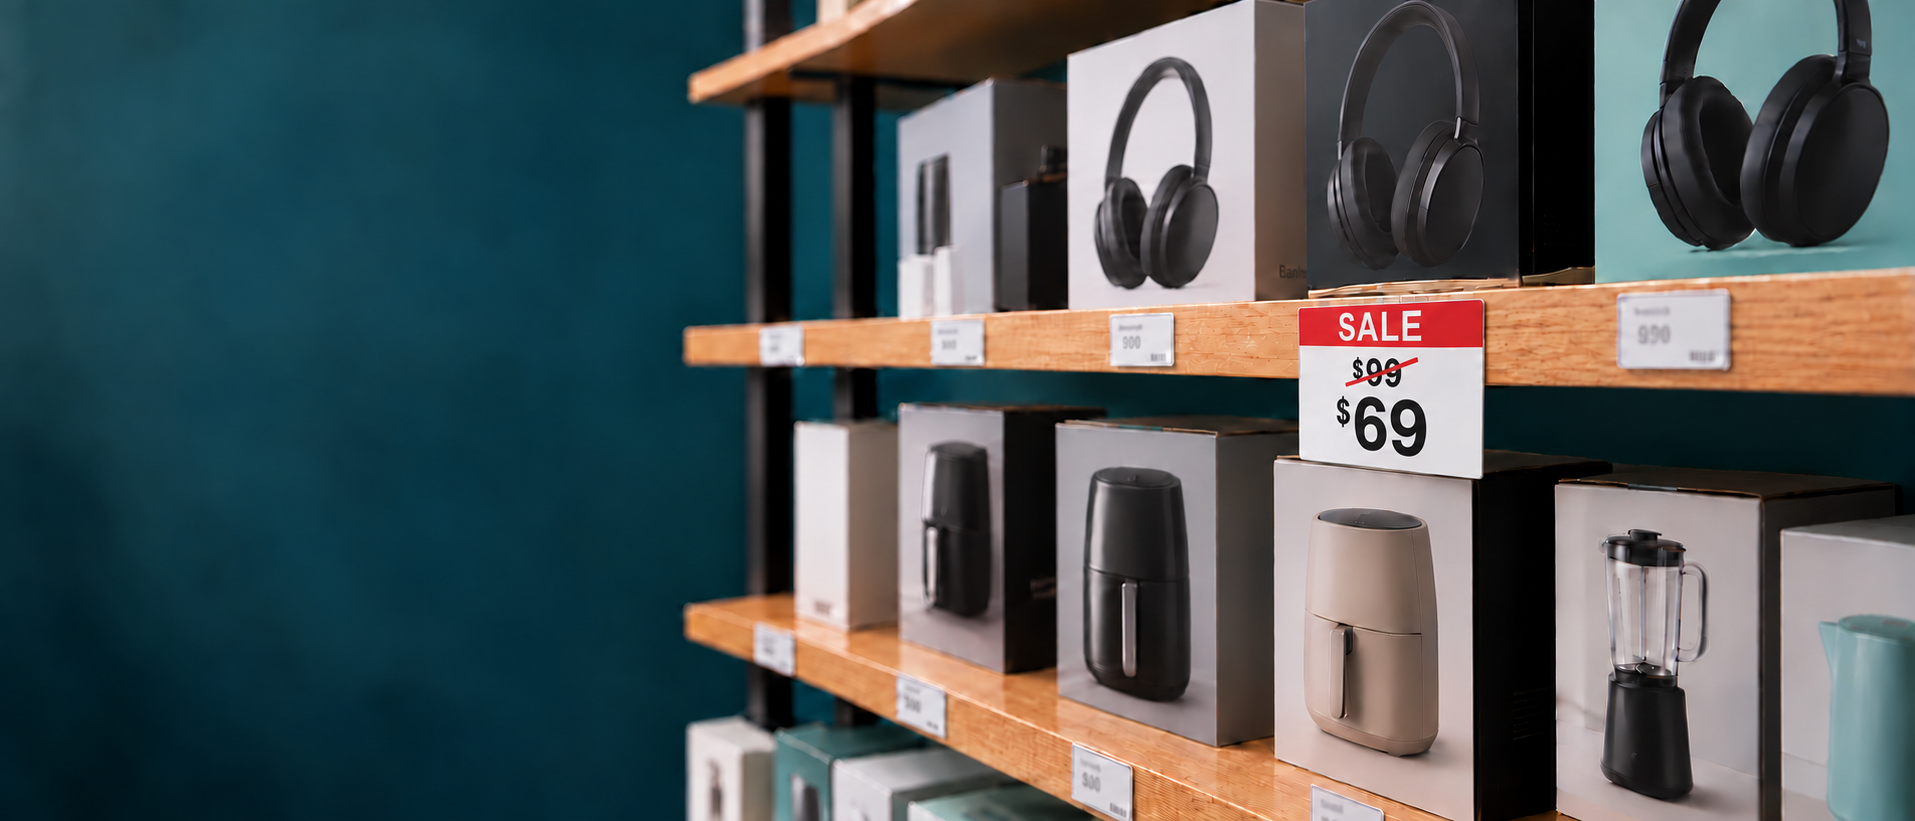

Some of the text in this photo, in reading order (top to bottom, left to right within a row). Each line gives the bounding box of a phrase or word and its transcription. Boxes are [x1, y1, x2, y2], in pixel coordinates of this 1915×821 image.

[1338, 310, 1422, 342] SALE
[1352, 357, 1402, 388] $99
[1336, 396, 1427, 457] $69
